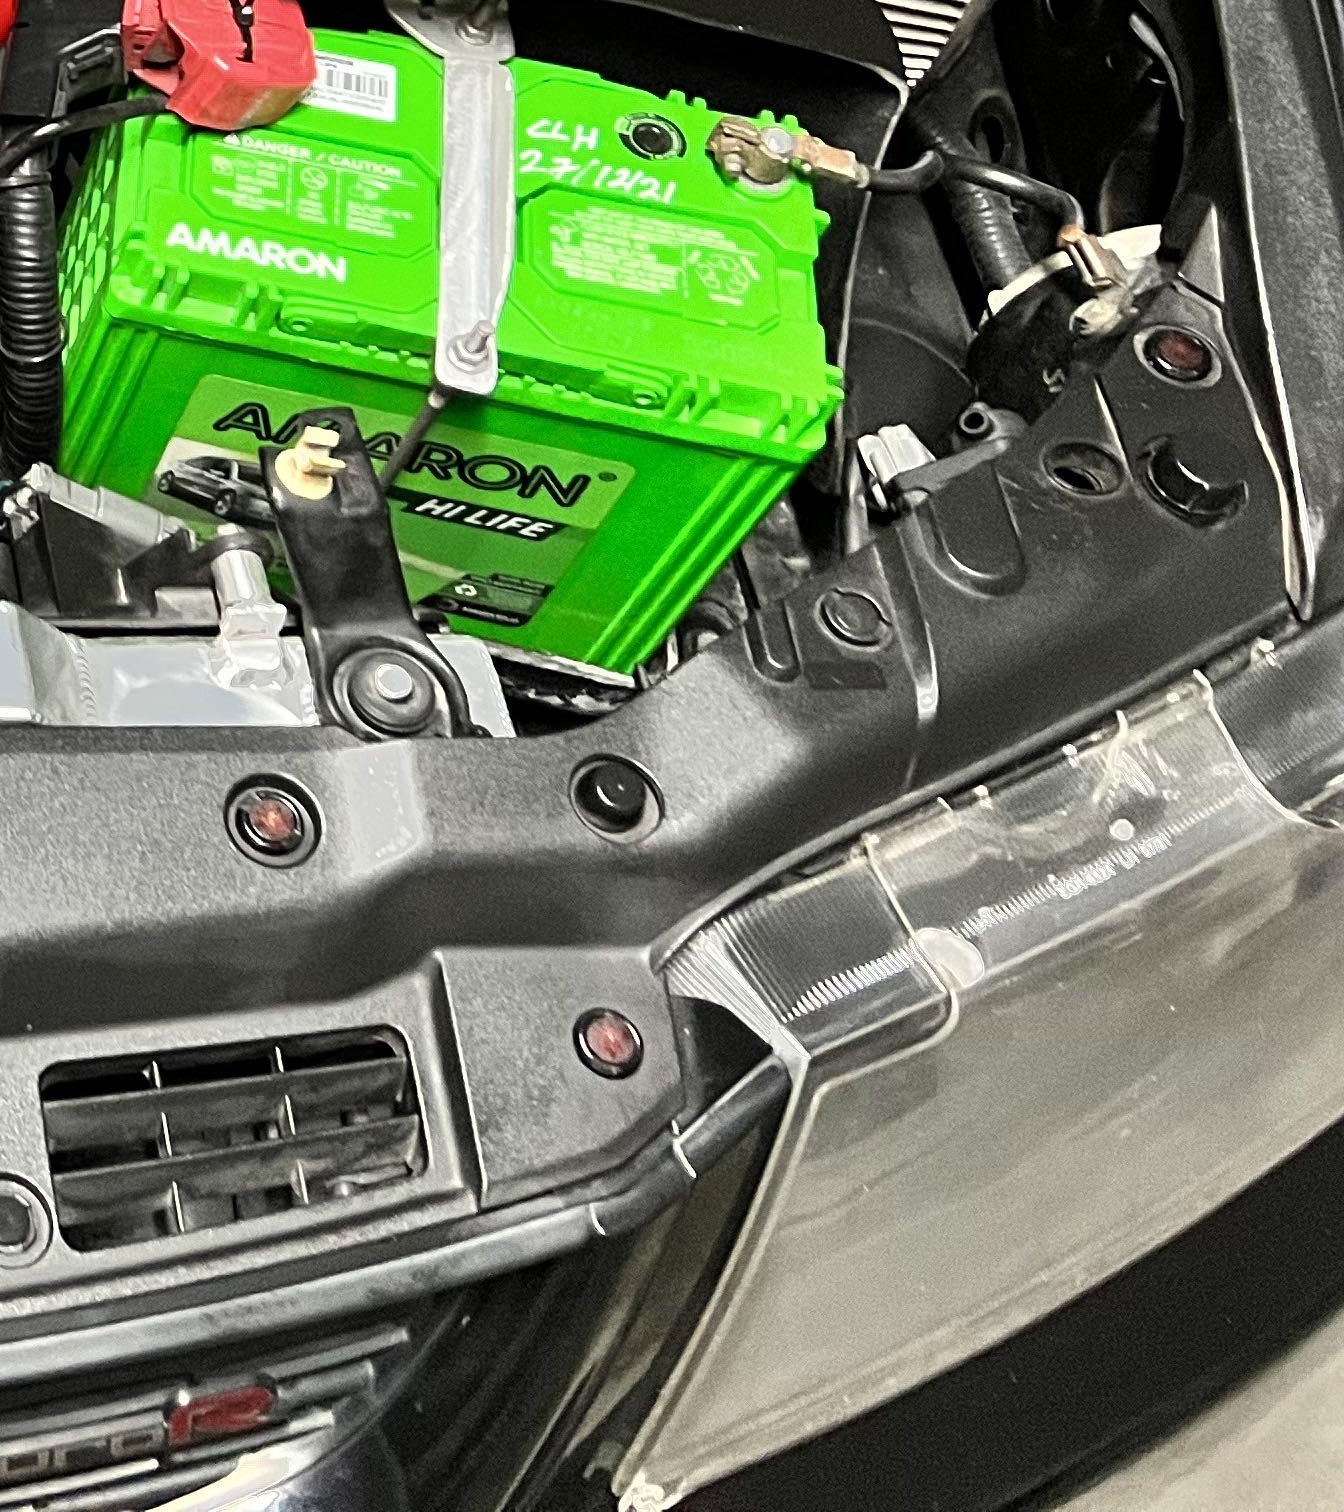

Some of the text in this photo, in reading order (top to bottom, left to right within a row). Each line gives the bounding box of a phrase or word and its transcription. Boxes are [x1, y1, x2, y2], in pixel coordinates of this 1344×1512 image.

[240, 135, 311, 160] DANGER
[327, 154, 401, 178] CAUTION
[165, 222, 348, 283] AMARON
[415, 498, 556, 539] HI LIFE
